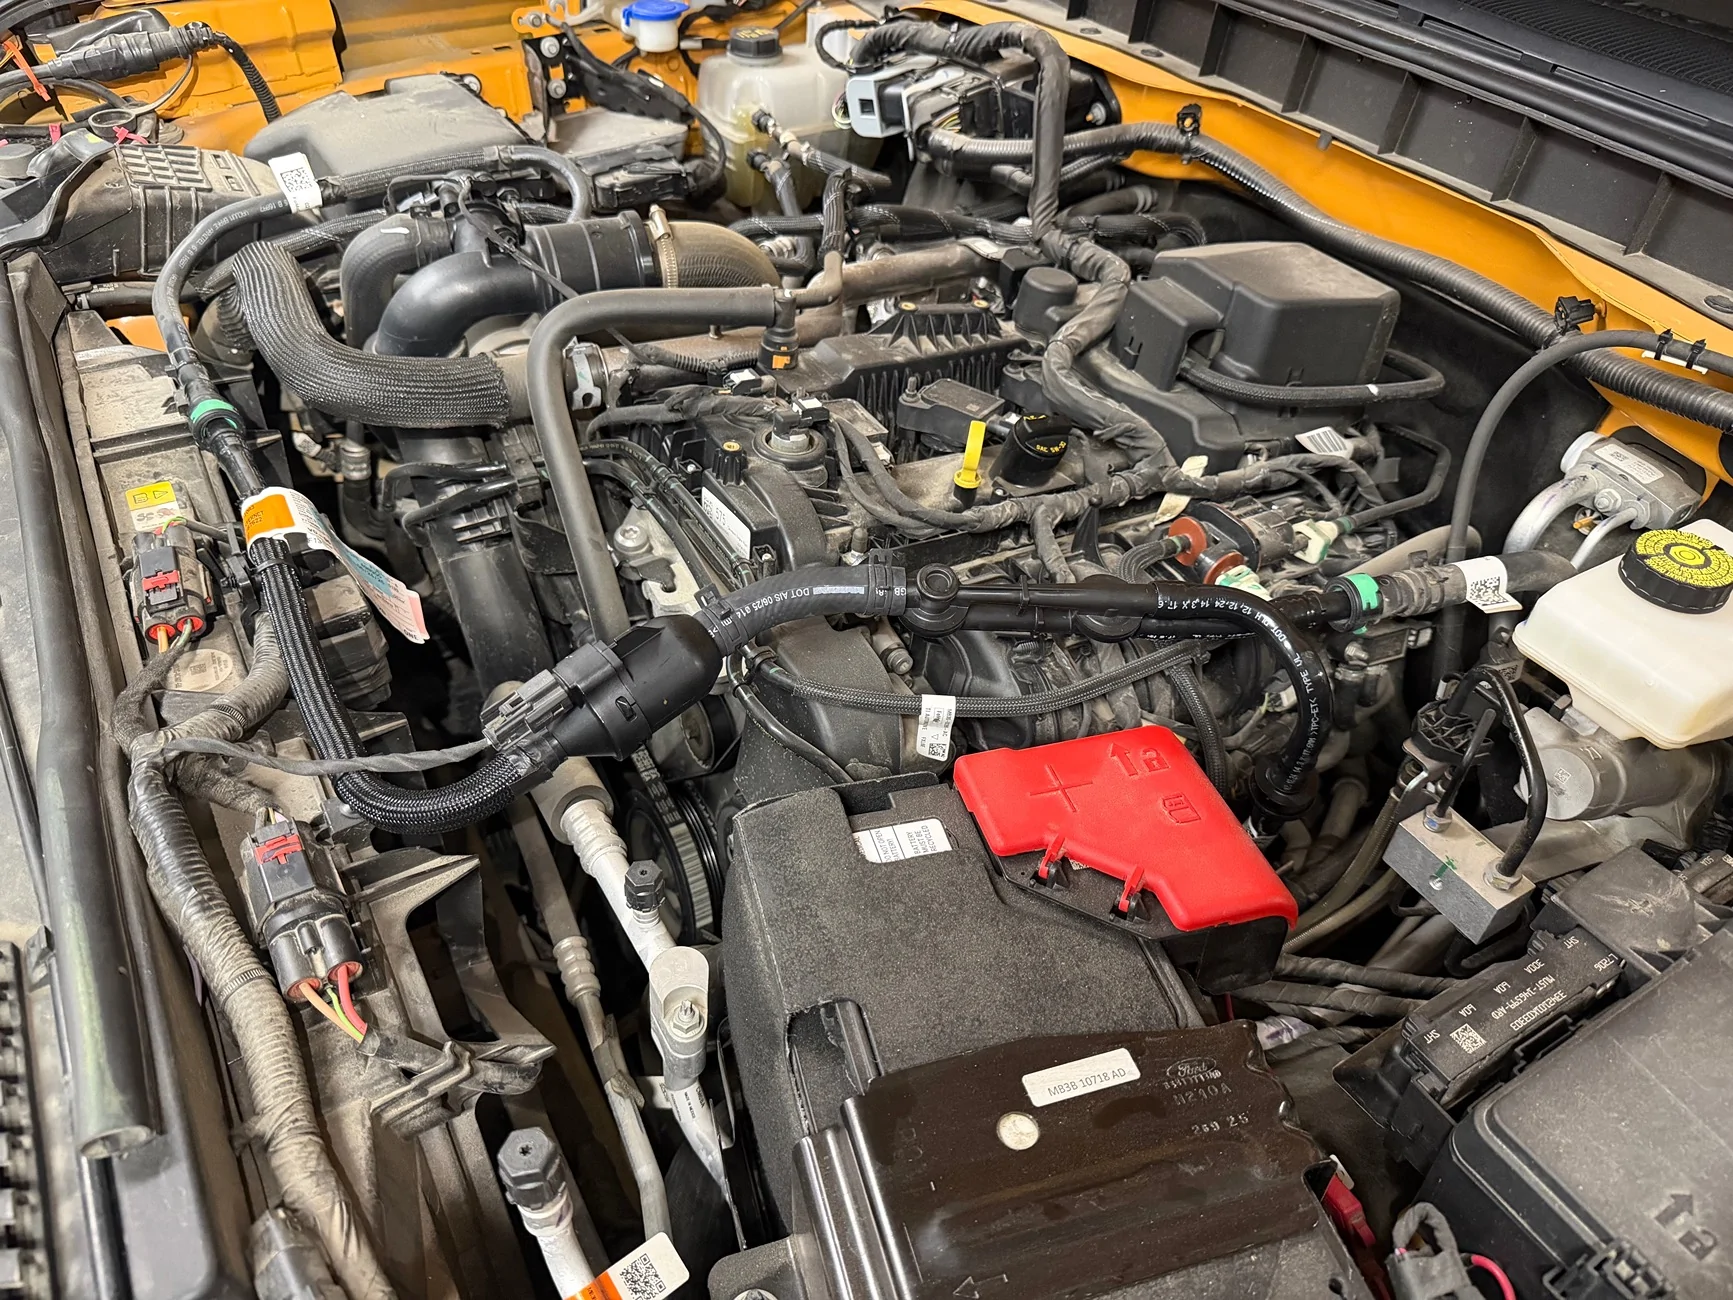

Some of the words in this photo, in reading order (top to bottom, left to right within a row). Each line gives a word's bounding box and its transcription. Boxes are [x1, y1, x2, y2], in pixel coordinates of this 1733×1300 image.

[775, 590, 789, 604] AIS
[791, 587, 810, 599] DOT
[752, 596, 774, 612] 06/25
[1270, 625, 1288, 643] DOT
[1293, 653, 1304, 669] UL
[1300, 669, 1315, 694] TYPE
[874, 830, 885, 844] OPEN
[906, 831, 921, 854] BATTERY
[921, 825, 938, 852] RECYCLED
[879, 844, 889, 858] NOT
[918, 839, 929, 854] MUST
[1524, 958, 1545, 974] 300A
[1047, 1081, 1079, 1098] MB3B
[1079, 1071, 1111, 1090] 10718
[1112, 1067, 1127, 1083] AD
[1229, 1111, 1249, 1128] 25
